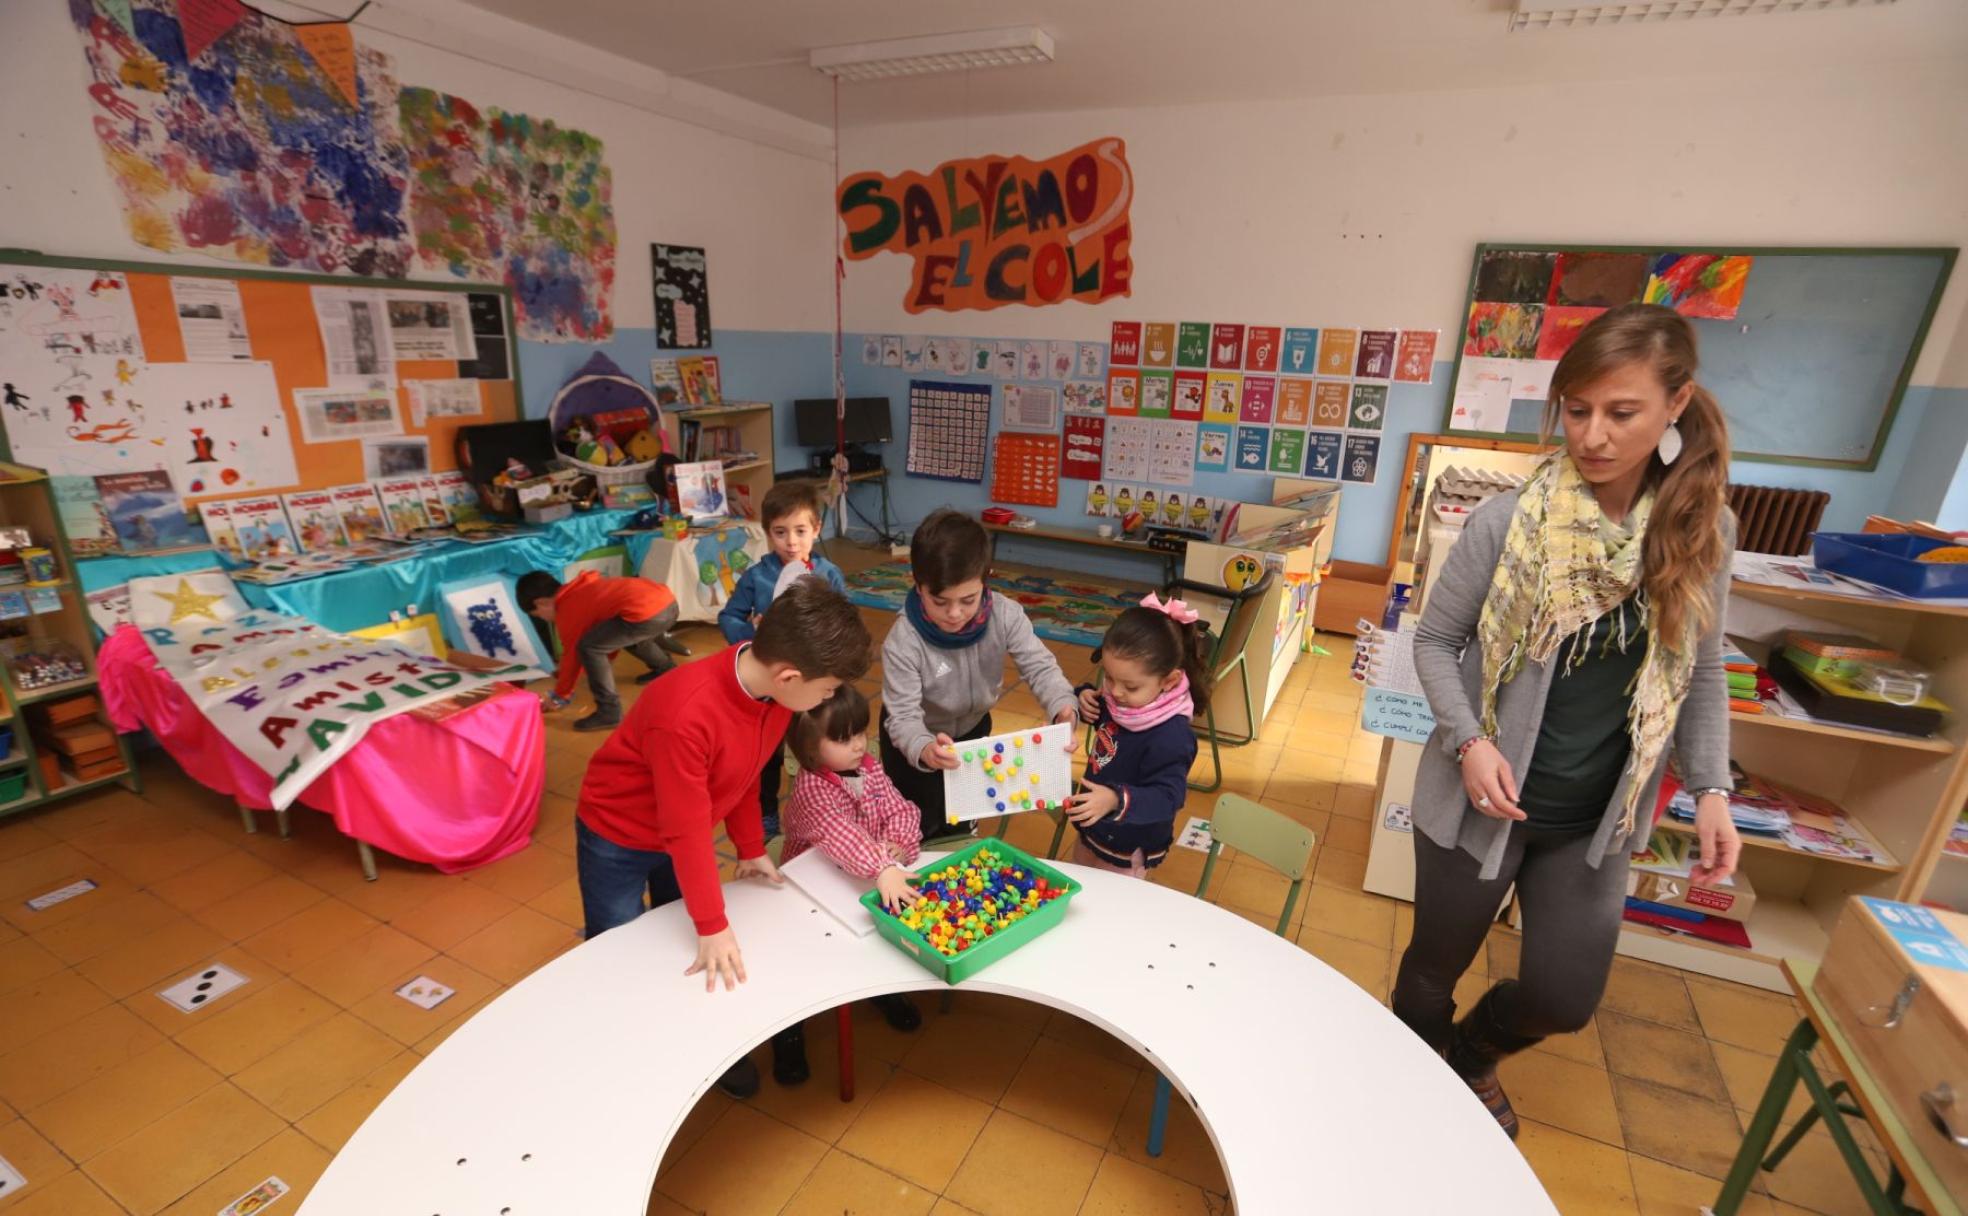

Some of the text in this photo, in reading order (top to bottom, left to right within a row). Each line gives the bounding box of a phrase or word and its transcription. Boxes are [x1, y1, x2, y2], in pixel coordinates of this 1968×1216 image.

[840, 137, 1130, 253] SALVEMOS
[915, 225, 1130, 306] EL COLE
[1355, 387, 1363, 398] 13
[1311, 434, 1318, 445] 16
[1347, 439, 1355, 448] 17
[233, 501, 279, 514] HOMBRE
